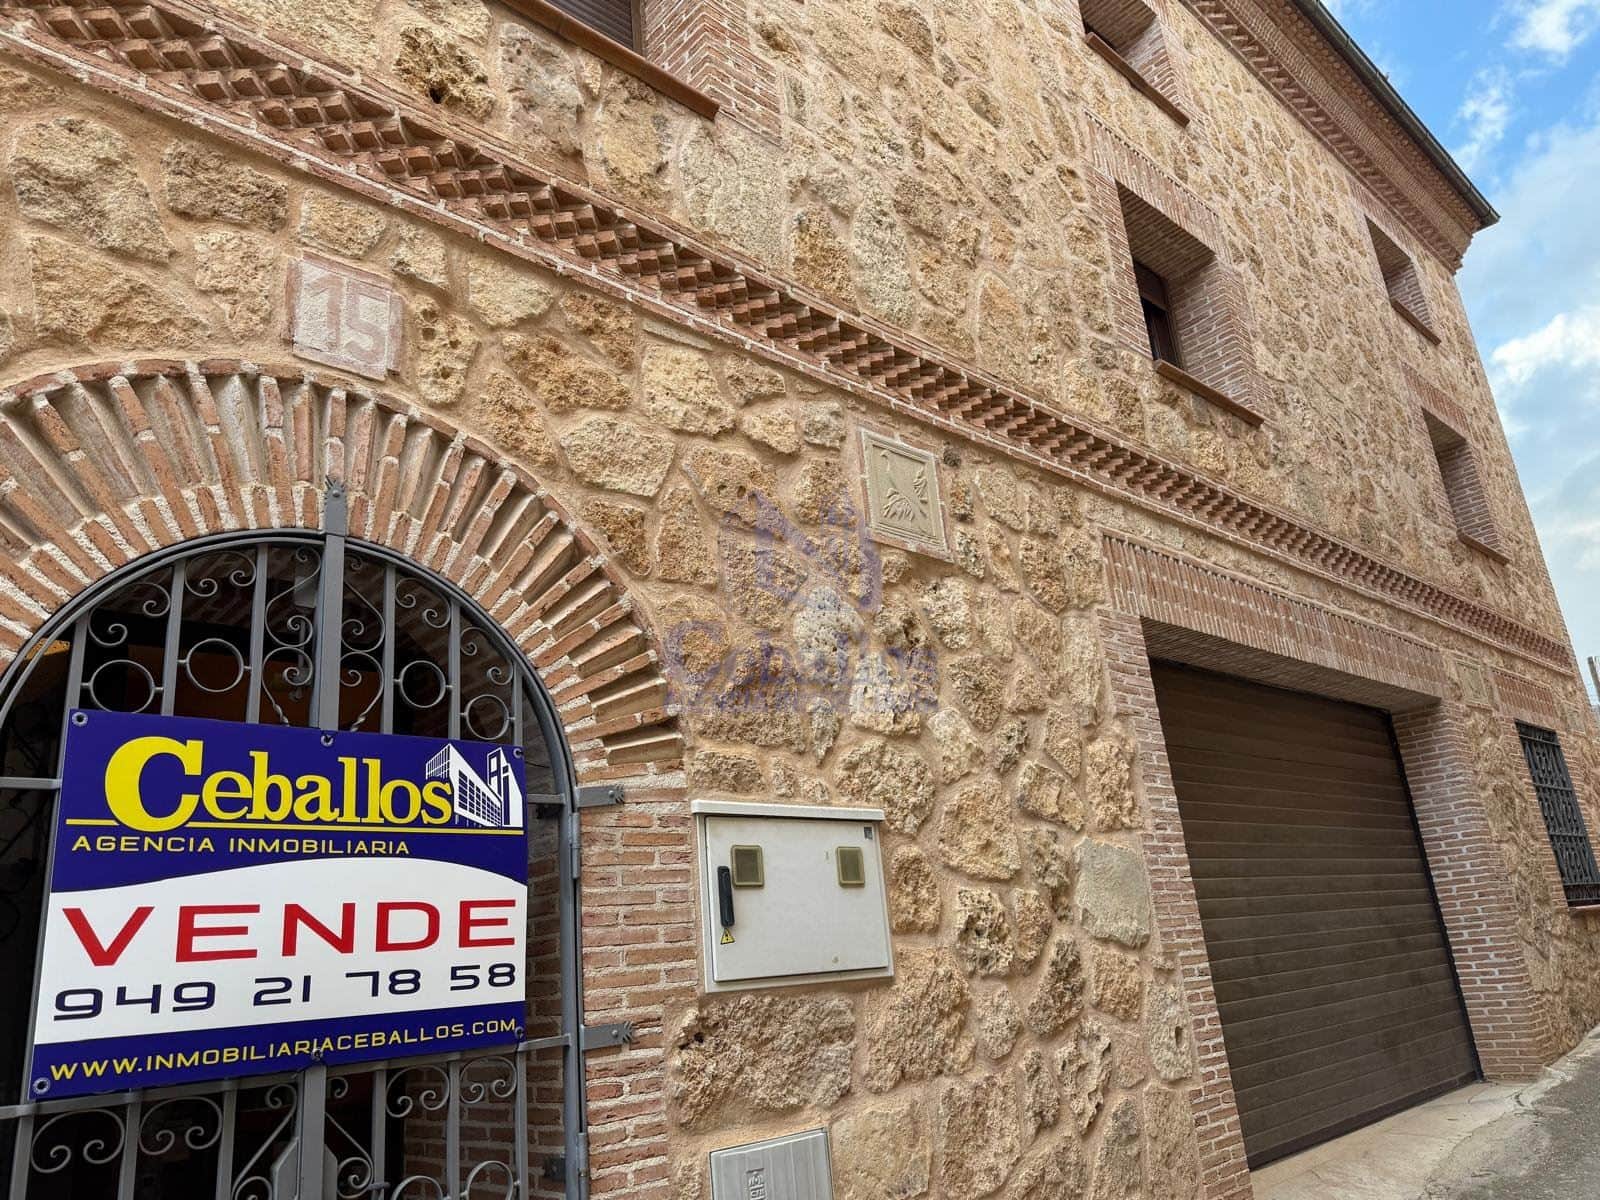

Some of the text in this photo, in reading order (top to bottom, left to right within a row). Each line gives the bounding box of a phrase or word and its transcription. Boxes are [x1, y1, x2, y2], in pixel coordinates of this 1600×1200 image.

[306, 274, 388, 365] 15
[104, 736, 452, 832] Ceballos
[72, 836, 410, 856] AGENCIA INMOBILIARIA
[62, 900, 516, 966] VENDE
[53, 962, 516, 1021] 949 21 78 58
[51, 1019, 515, 1081] WWW.INMOBILIARIACEBALLOS.COM
